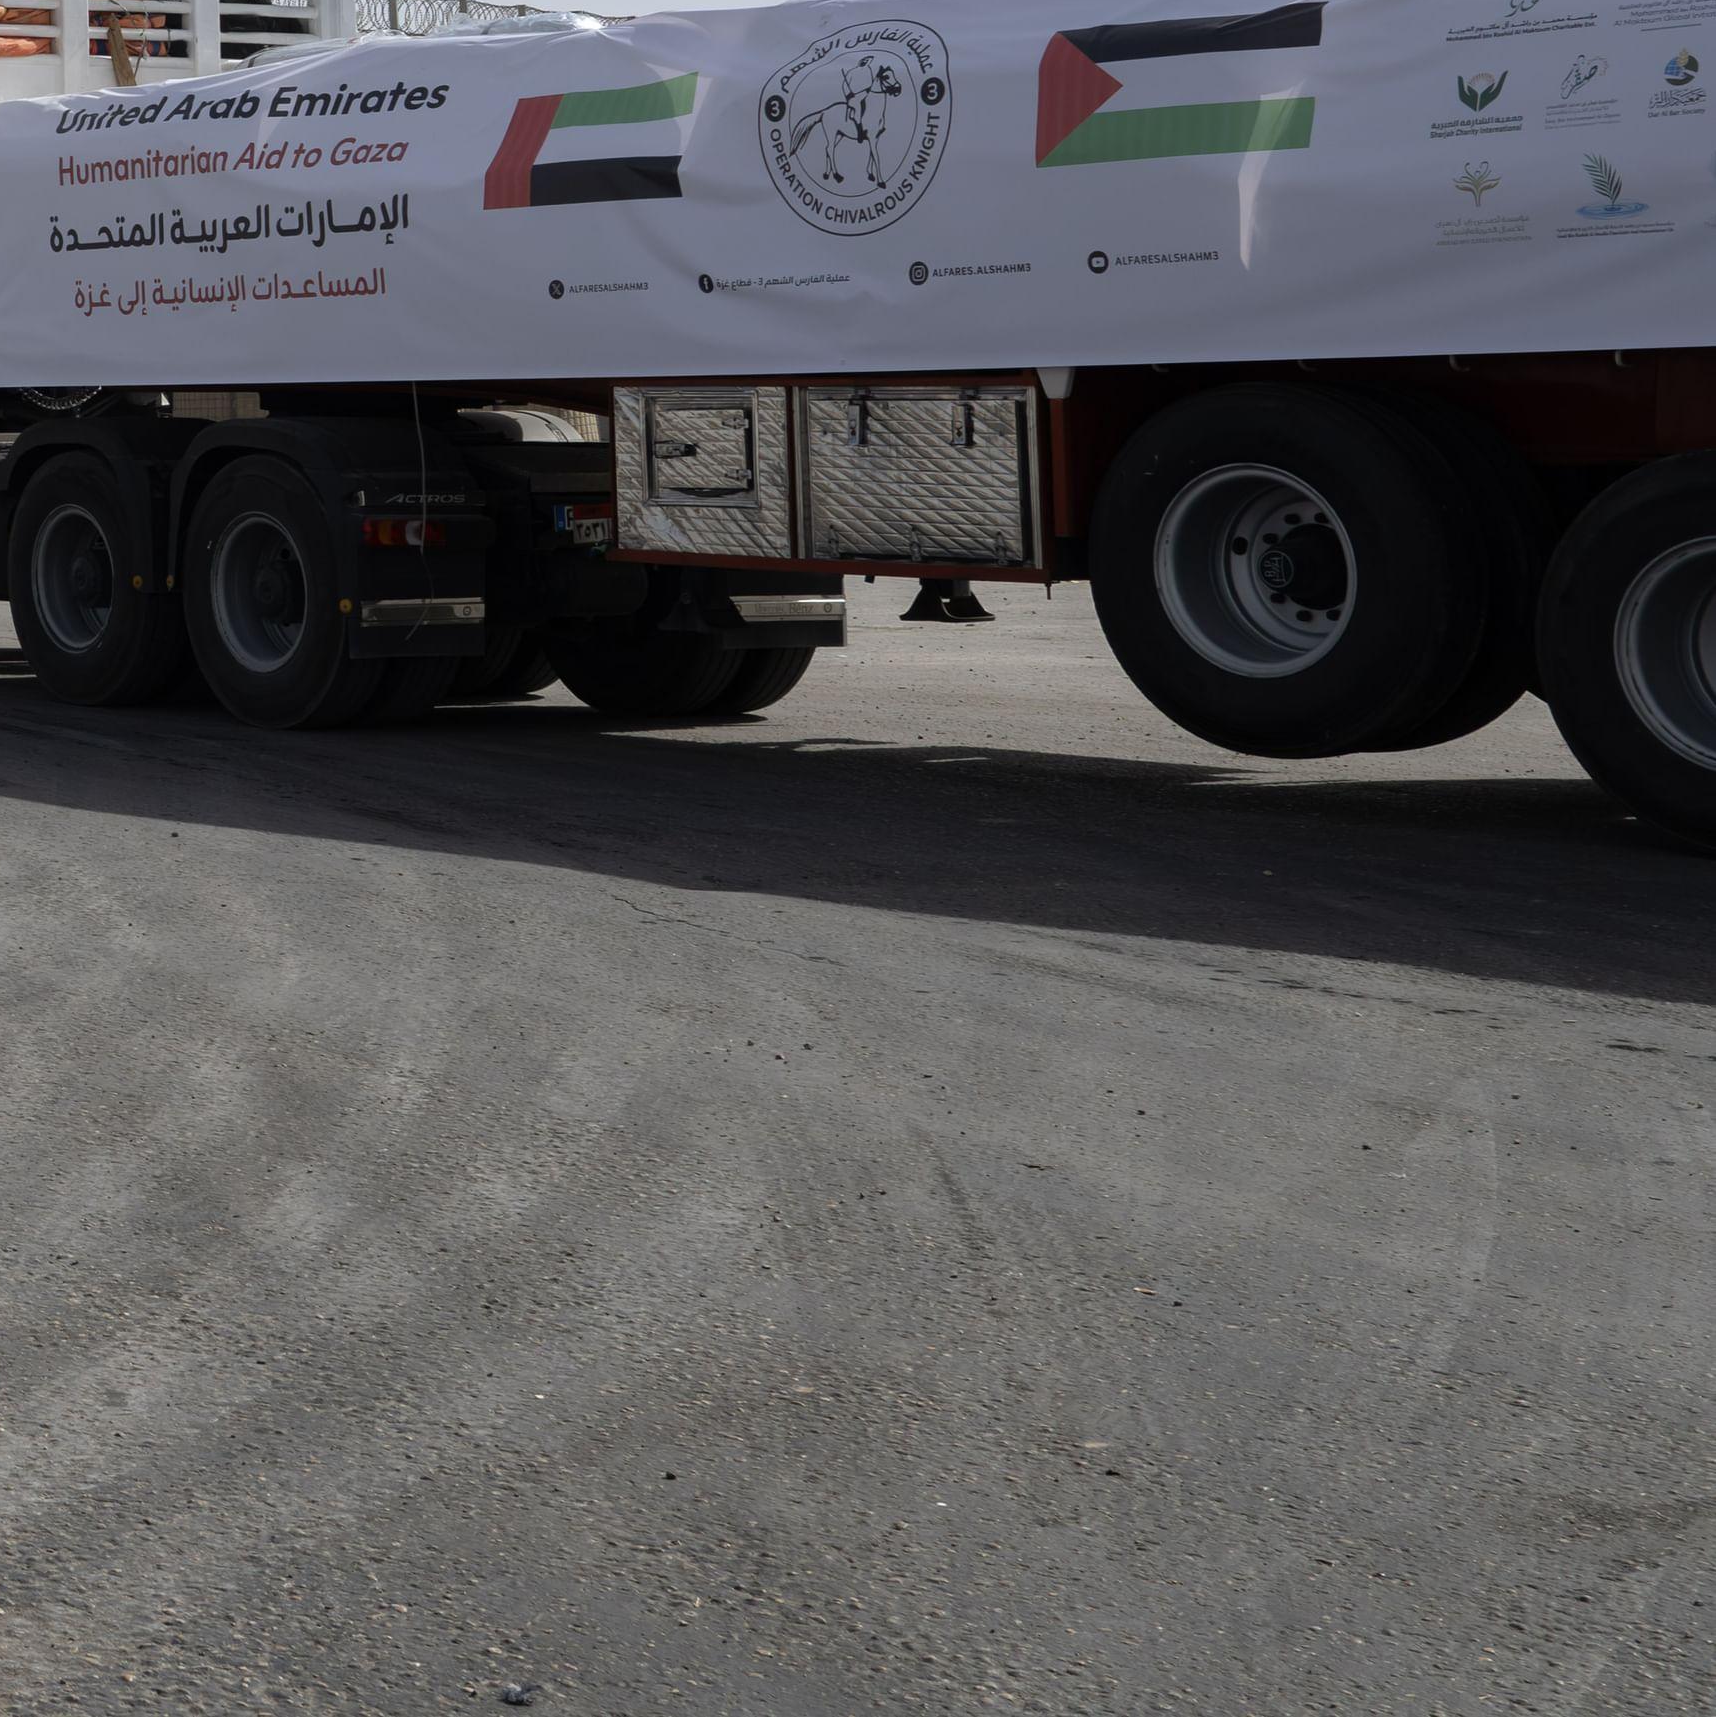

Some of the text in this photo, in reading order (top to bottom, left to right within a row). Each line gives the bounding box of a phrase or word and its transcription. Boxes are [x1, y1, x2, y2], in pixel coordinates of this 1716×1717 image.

[55, 81, 451, 134] United Arab Emirates
[57, 136, 410, 187] Humanitarian Aid to Gaza
[769, 112, 941, 225] OPERATION CHIVALROUS KNIGHT
[49, 193, 410, 254] الإمارات العربية المتحدة
[932, 262, 1032, 279] ALFARES.ALSHAHM3
[1114, 250, 1220, 267] ALFARESALSHAHM3
[73, 266, 386, 317] المساعدات الإنسانية إلى غزة
[568, 282, 649, 294] ALFARESALSHAHM3
[384, 492, 466, 505] ACTROS
